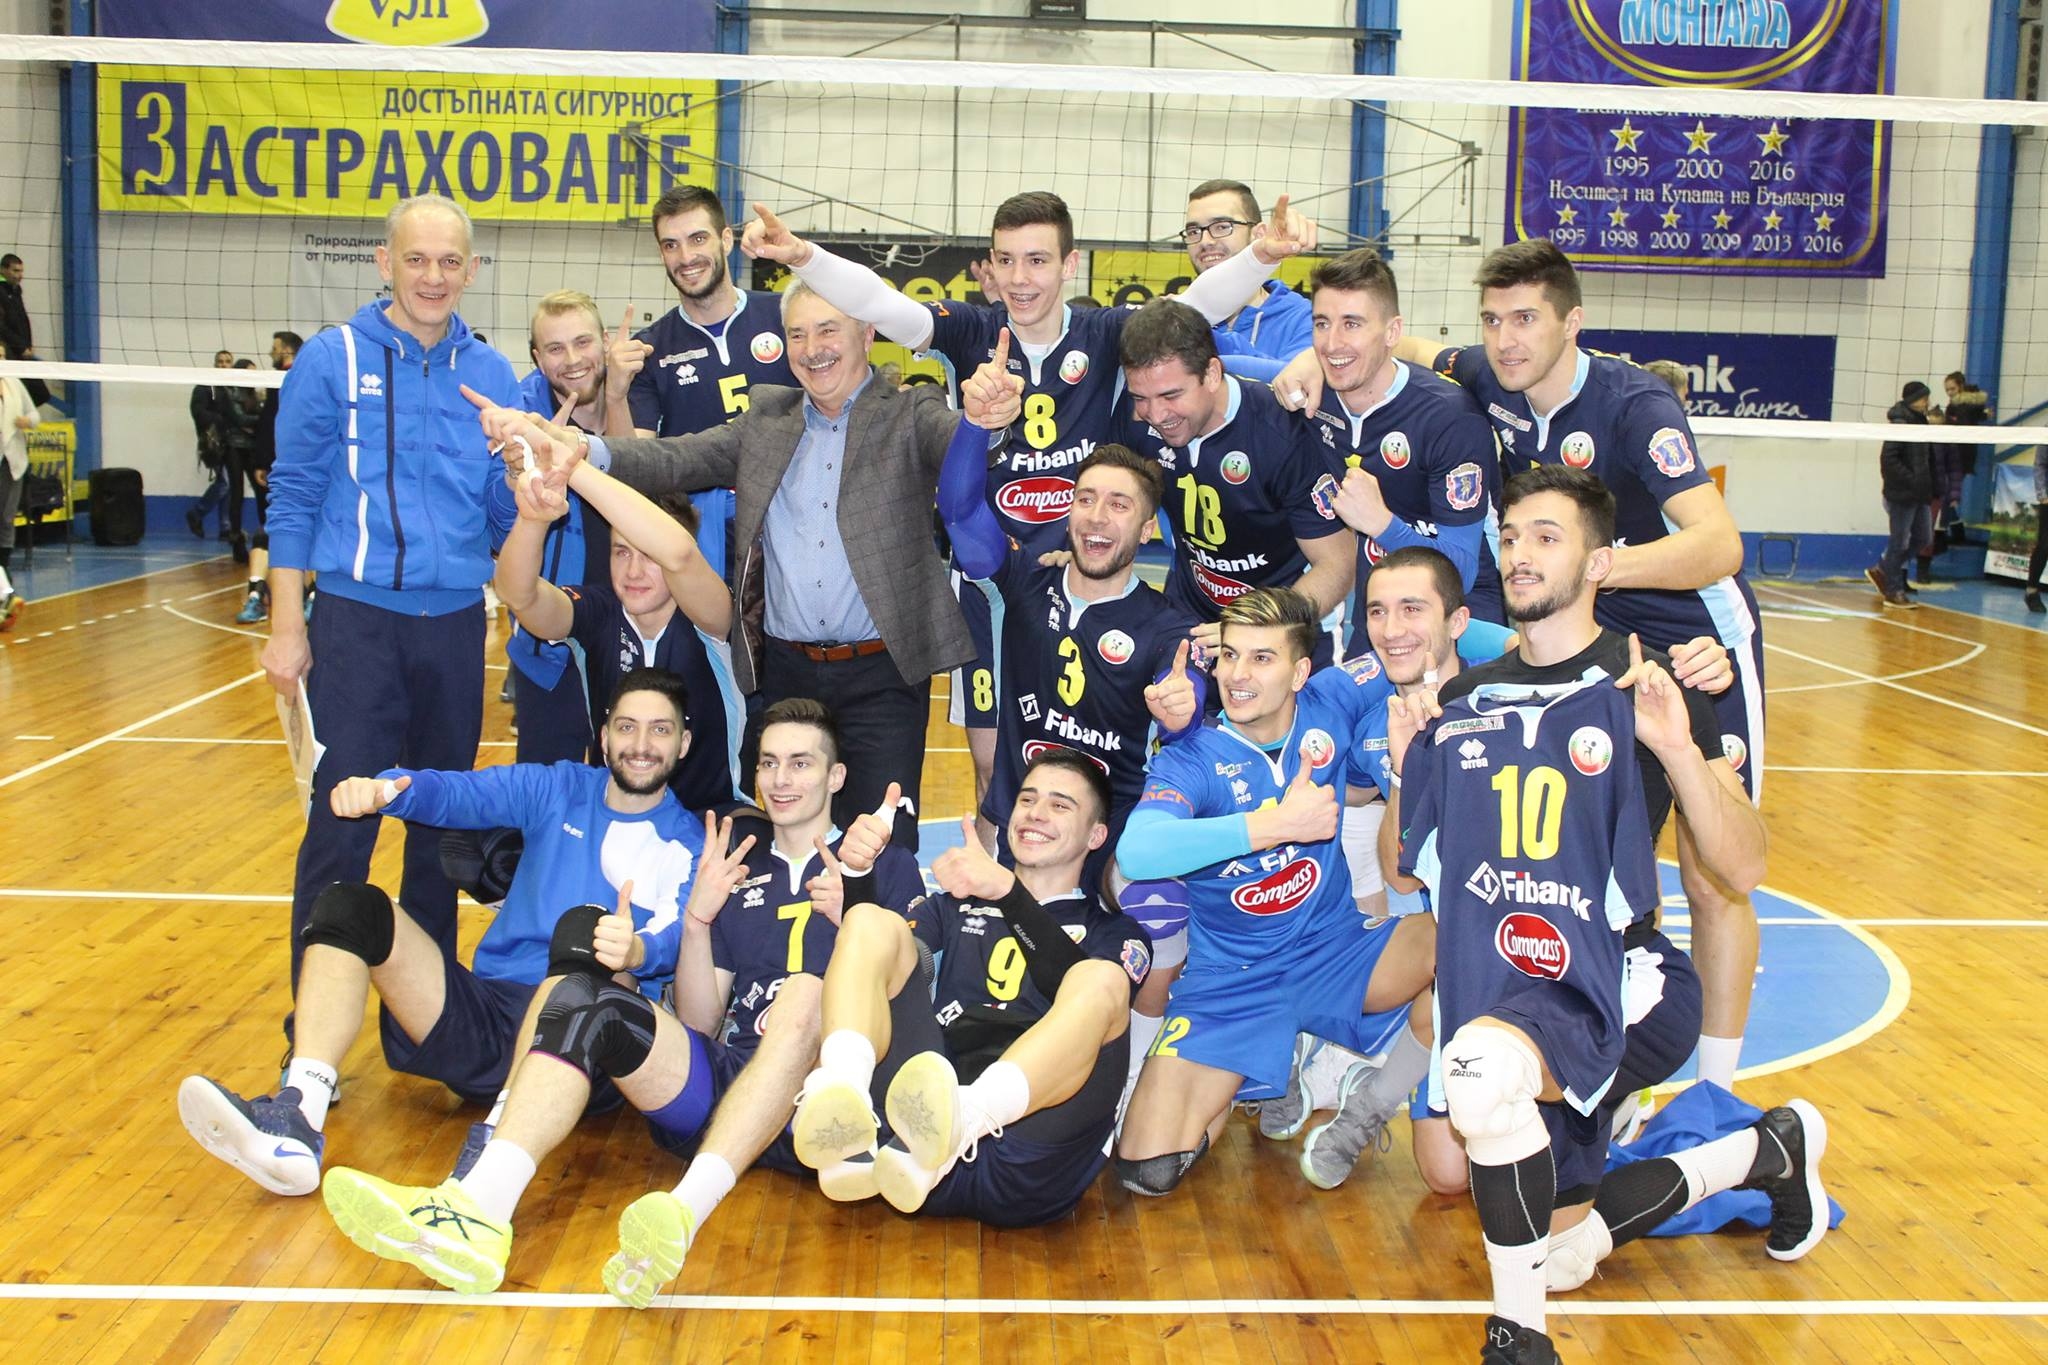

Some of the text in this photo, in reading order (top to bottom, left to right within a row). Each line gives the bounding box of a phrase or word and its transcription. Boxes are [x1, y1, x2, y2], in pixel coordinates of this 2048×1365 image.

[1620, 0, 1790, 48] МОНТАНА
[383, 87, 693, 121] ДОСТЪПНАТА СИГУРНОСТ
[1605, 156, 1650, 177] 1995
[1676, 159, 1723, 180] 2000
[1750, 160, 1796, 182] 2016
[1549, 179, 1844, 212] Носител на Купата на България
[1549, 229, 1585, 245] 1995
[1600, 230, 1638, 248] 1998
[1651, 231, 1690, 250] 2000
[1702, 233, 1741, 251] 2009
[1753, 234, 1792, 252] 2013
[1804, 235, 1843, 253] 2016
[323, 252, 377, 265] природ
[718, 374, 750, 423] 5
[1734, 388, 1808, 418] банка
[1024, 393, 1057, 450] 8
[1011, 438, 1097, 473] Fibank
[1177, 473, 1227, 546] 18
[1057, 635, 1086, 707] 3
[972, 668, 994, 712] 8
[1044, 707, 1122, 752] Fibank
[1491, 765, 1567, 861] 10
[1238, 861, 1313, 904] Compass
[1501, 870, 1593, 922] Fibank
[777, 900, 812, 973] 7
[1503, 923, 1562, 973] Compass
[986, 936, 1027, 1002] 9
